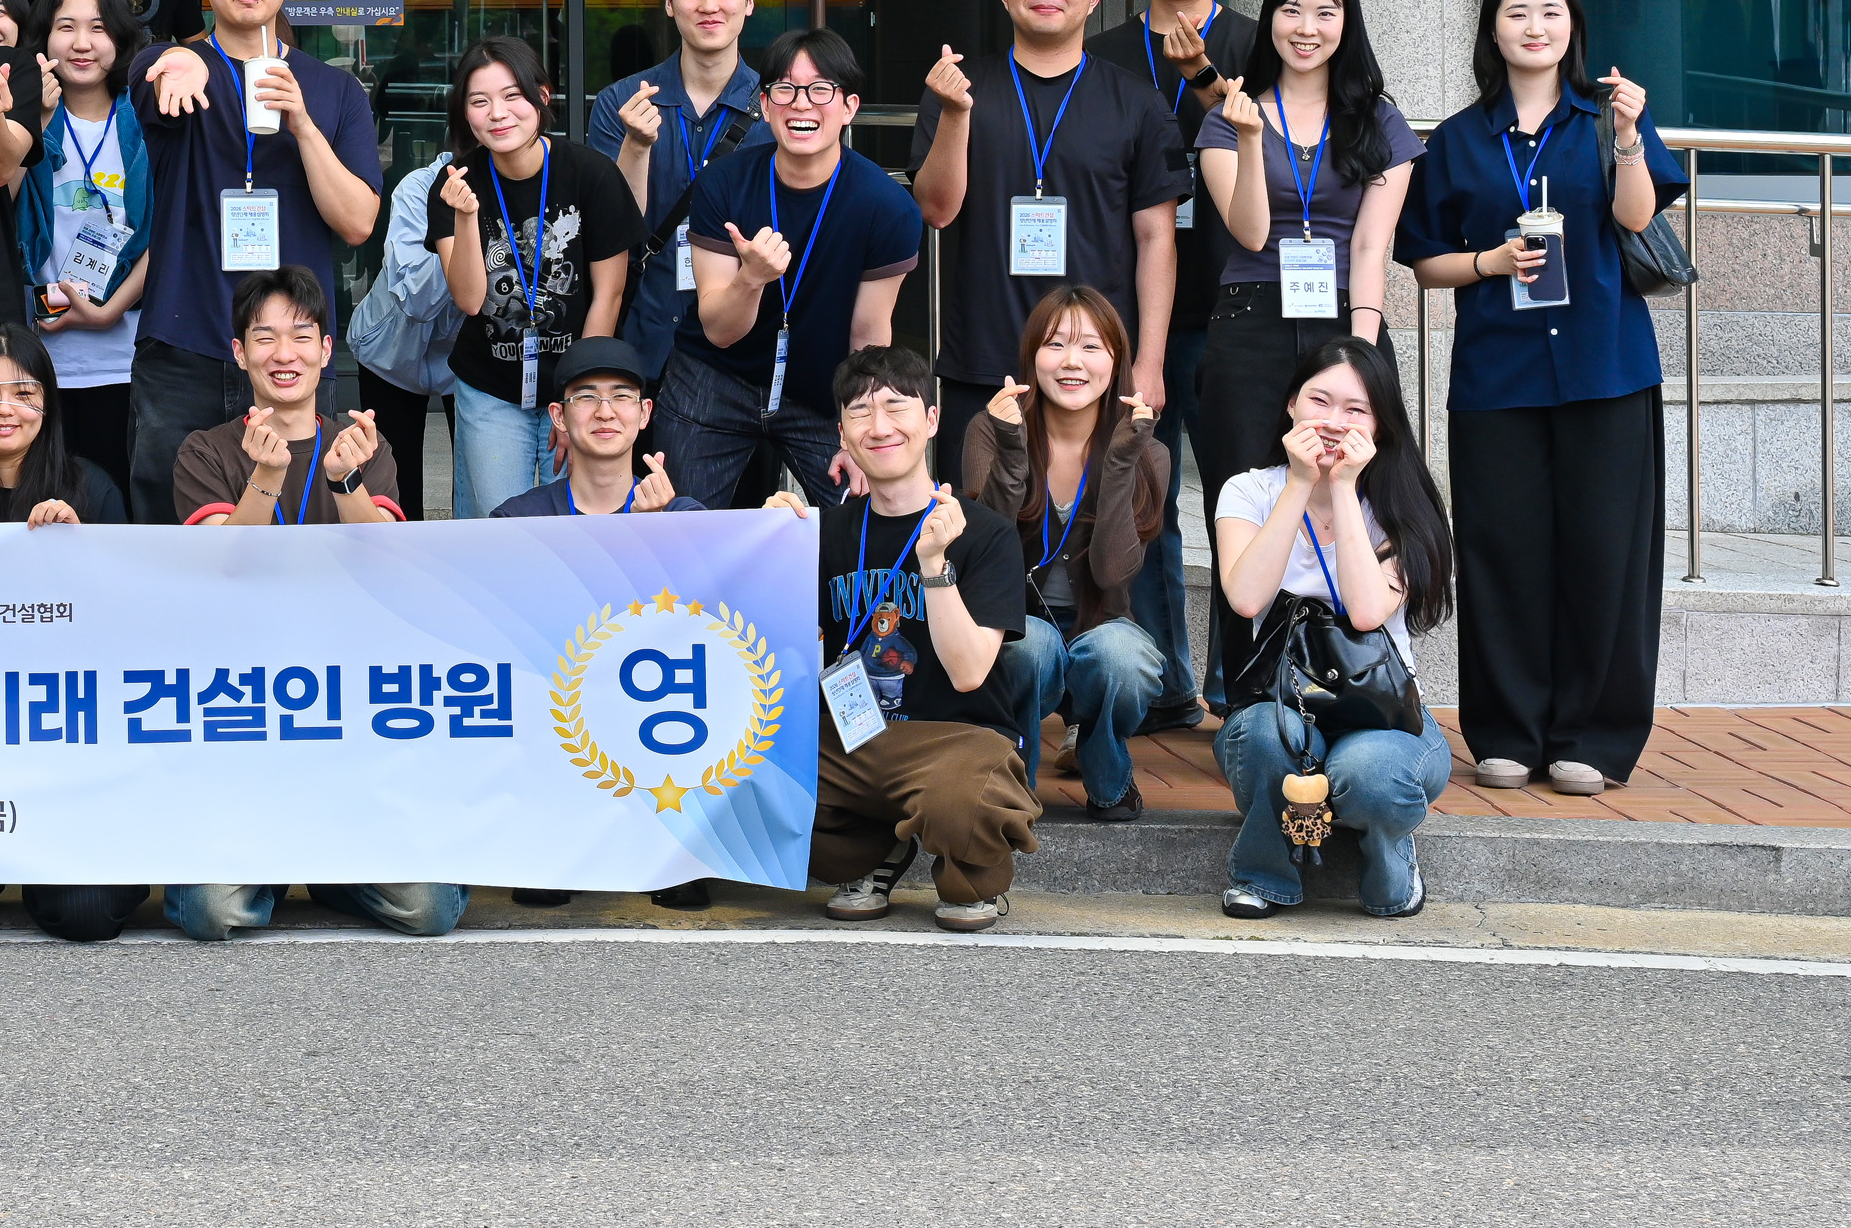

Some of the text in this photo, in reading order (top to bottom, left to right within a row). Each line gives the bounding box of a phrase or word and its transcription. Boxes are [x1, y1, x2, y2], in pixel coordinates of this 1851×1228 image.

[501, 282, 509, 292] 8
[492, 344, 516, 359] YOU
[829, 568, 925, 623] UNIVERSI
[871, 644, 882, 658] P
[123, 663, 345, 745] 건설인
[367, 661, 514, 740] 방원
[617, 641, 710, 757] 영
